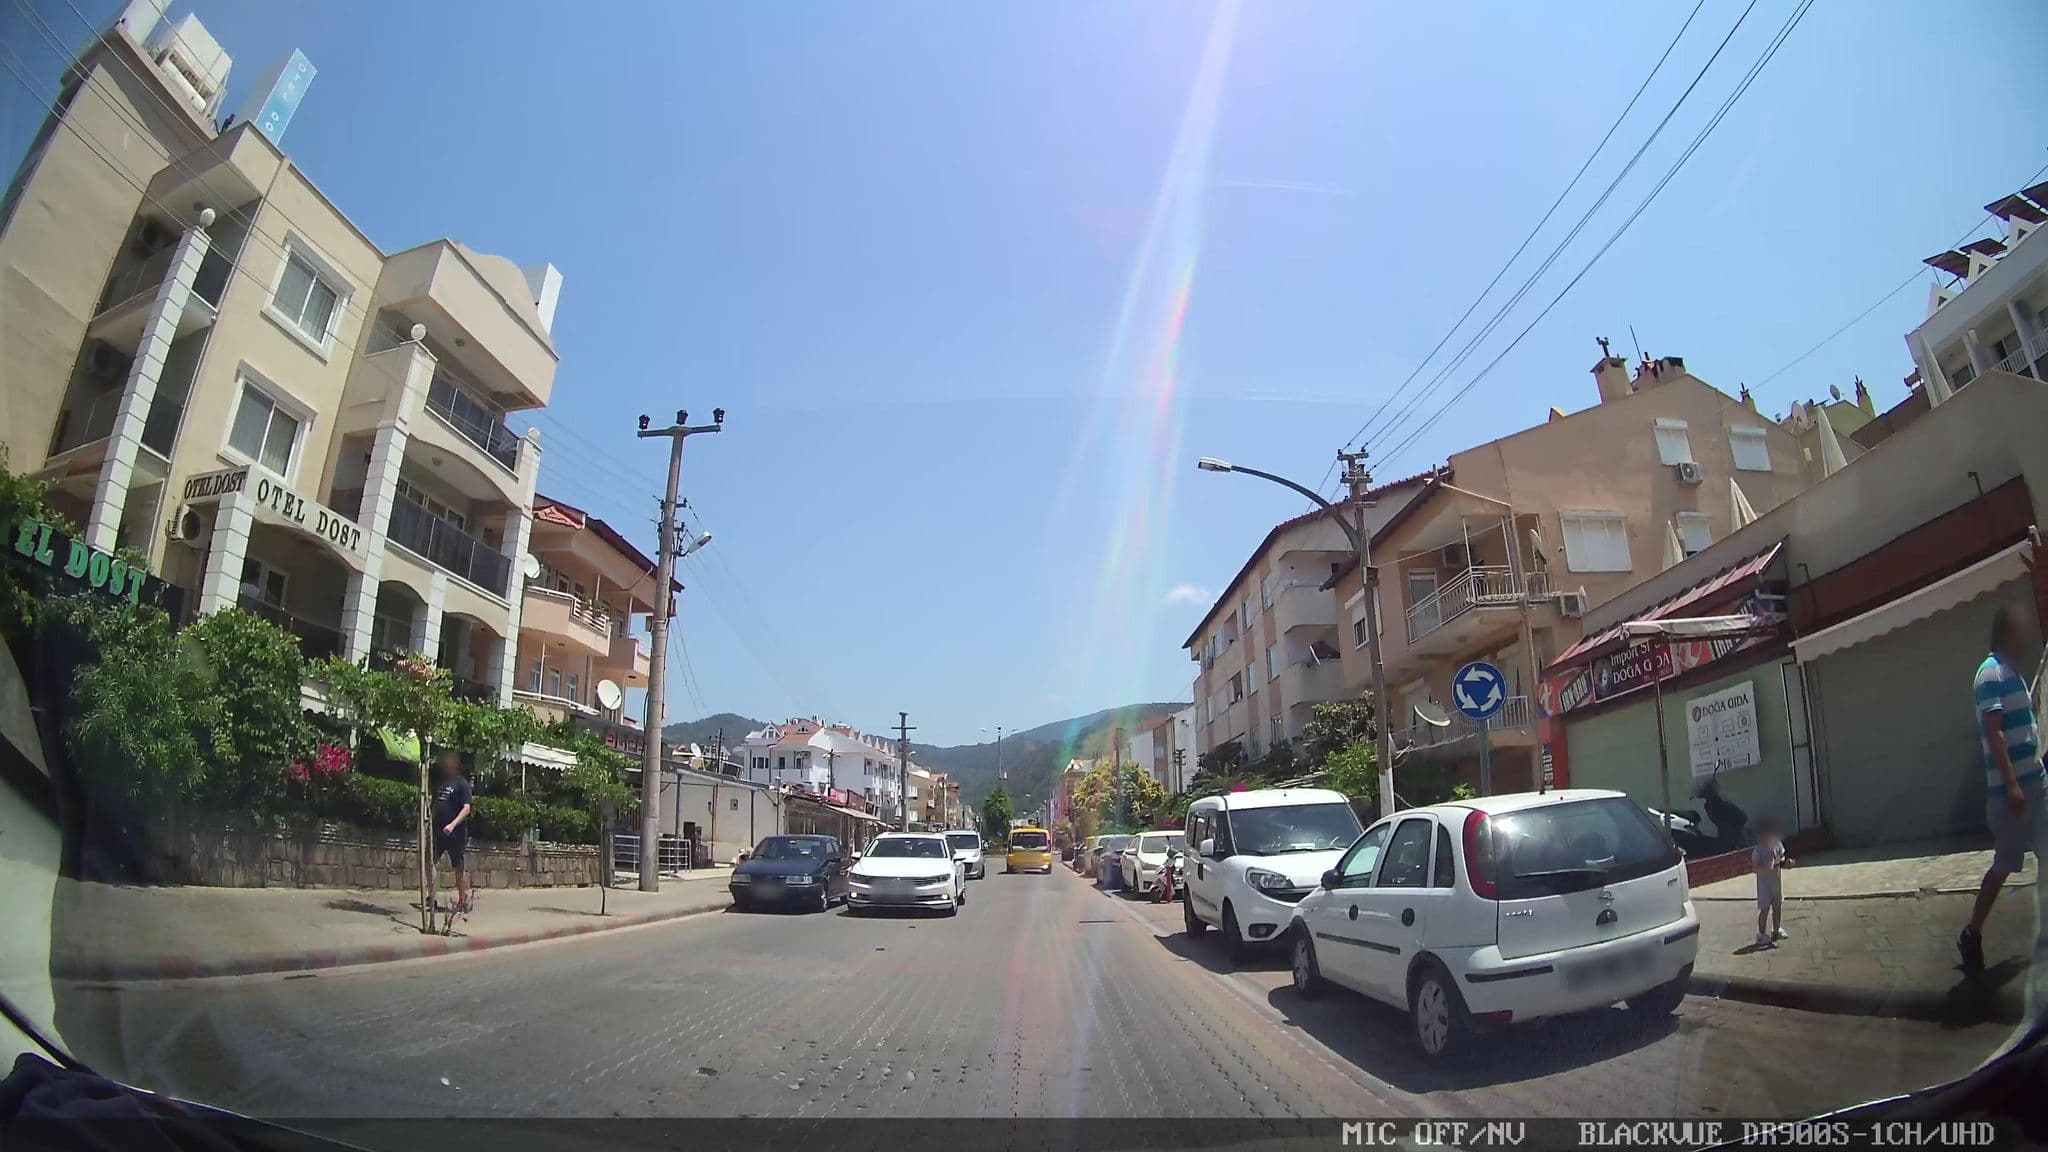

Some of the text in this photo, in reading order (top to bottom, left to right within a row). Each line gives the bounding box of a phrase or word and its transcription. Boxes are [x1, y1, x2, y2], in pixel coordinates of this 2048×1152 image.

[184, 471, 246, 499] OTEL DOST
[257, 479, 360, 551] OTEL DOST
[10, 517, 147, 605] EL DOST
[1643, 652, 1670, 673] GDA
